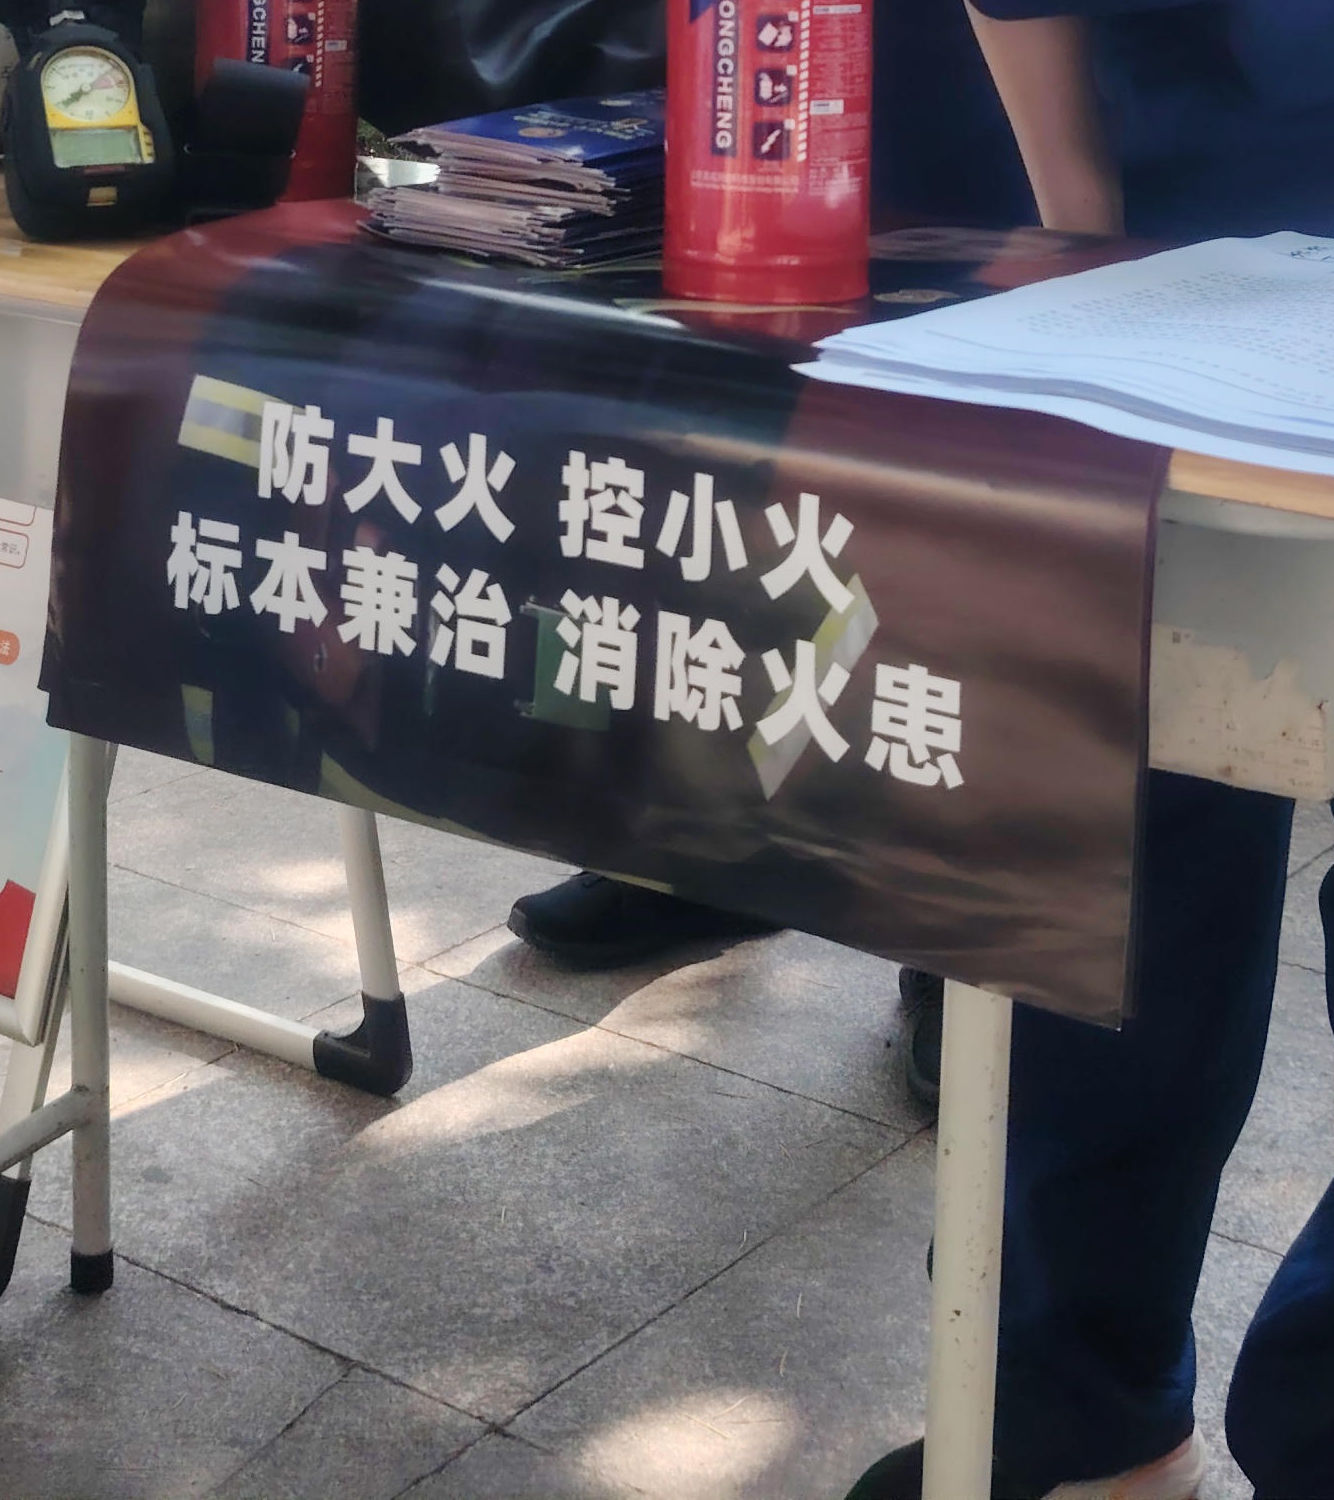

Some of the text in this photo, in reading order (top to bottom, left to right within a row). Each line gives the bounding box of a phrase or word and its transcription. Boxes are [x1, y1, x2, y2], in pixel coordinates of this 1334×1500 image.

[259, 402, 858, 613] 防大火 控小火
[167, 511, 966, 791] 标本兼治 消除火患
